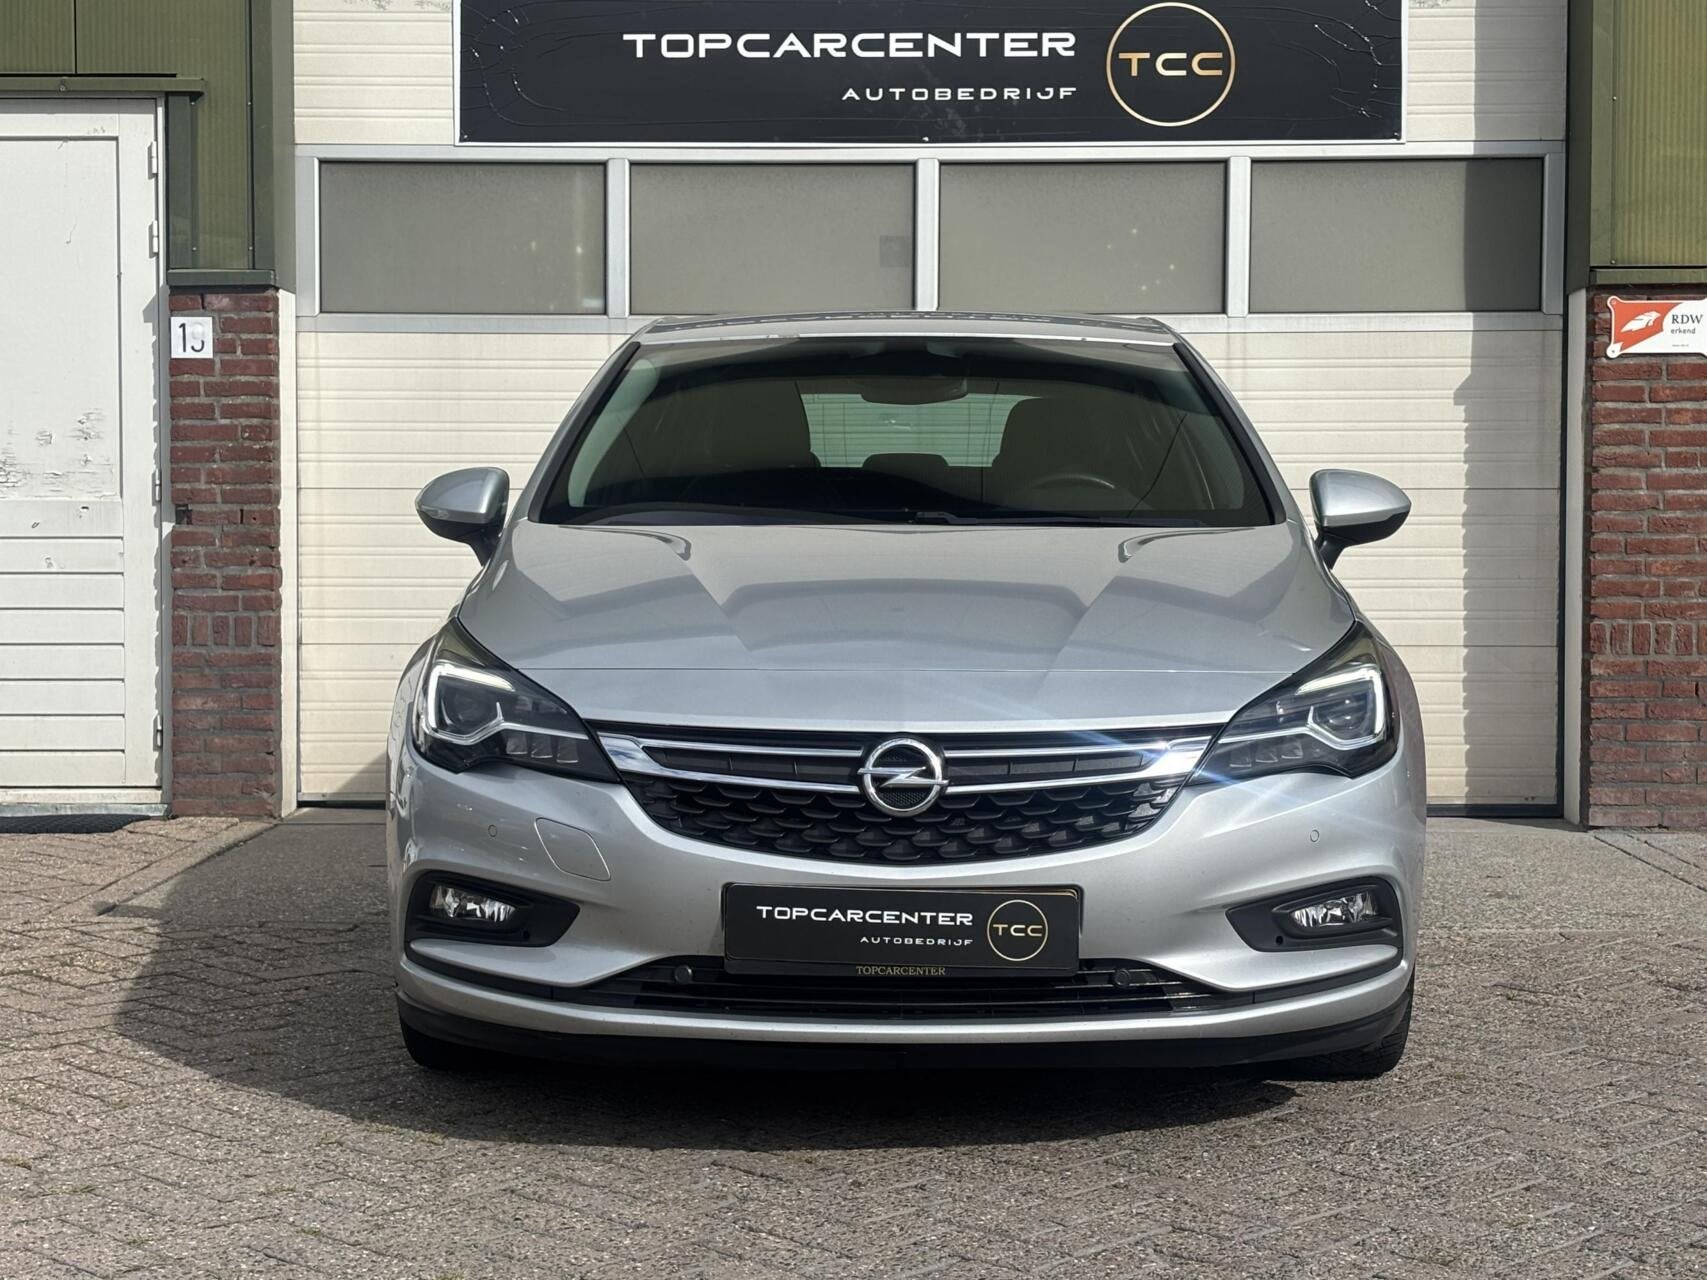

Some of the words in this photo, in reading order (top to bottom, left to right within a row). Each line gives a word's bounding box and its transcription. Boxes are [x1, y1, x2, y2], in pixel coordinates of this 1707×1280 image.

[622, 32, 1076, 58] TOPCARCENTER
[1118, 52, 1223, 77] TCC
[842, 87, 1077, 101] AUTOBEDRIJF
[1671, 314, 1703, 325] RDW
[755, 905, 974, 926] TOPCARCENTER
[993, 924, 1043, 937] TCC
[859, 936, 974, 947] AUTOBEDRIJF
[856, 965, 946, 977] TOPCARCENTER
